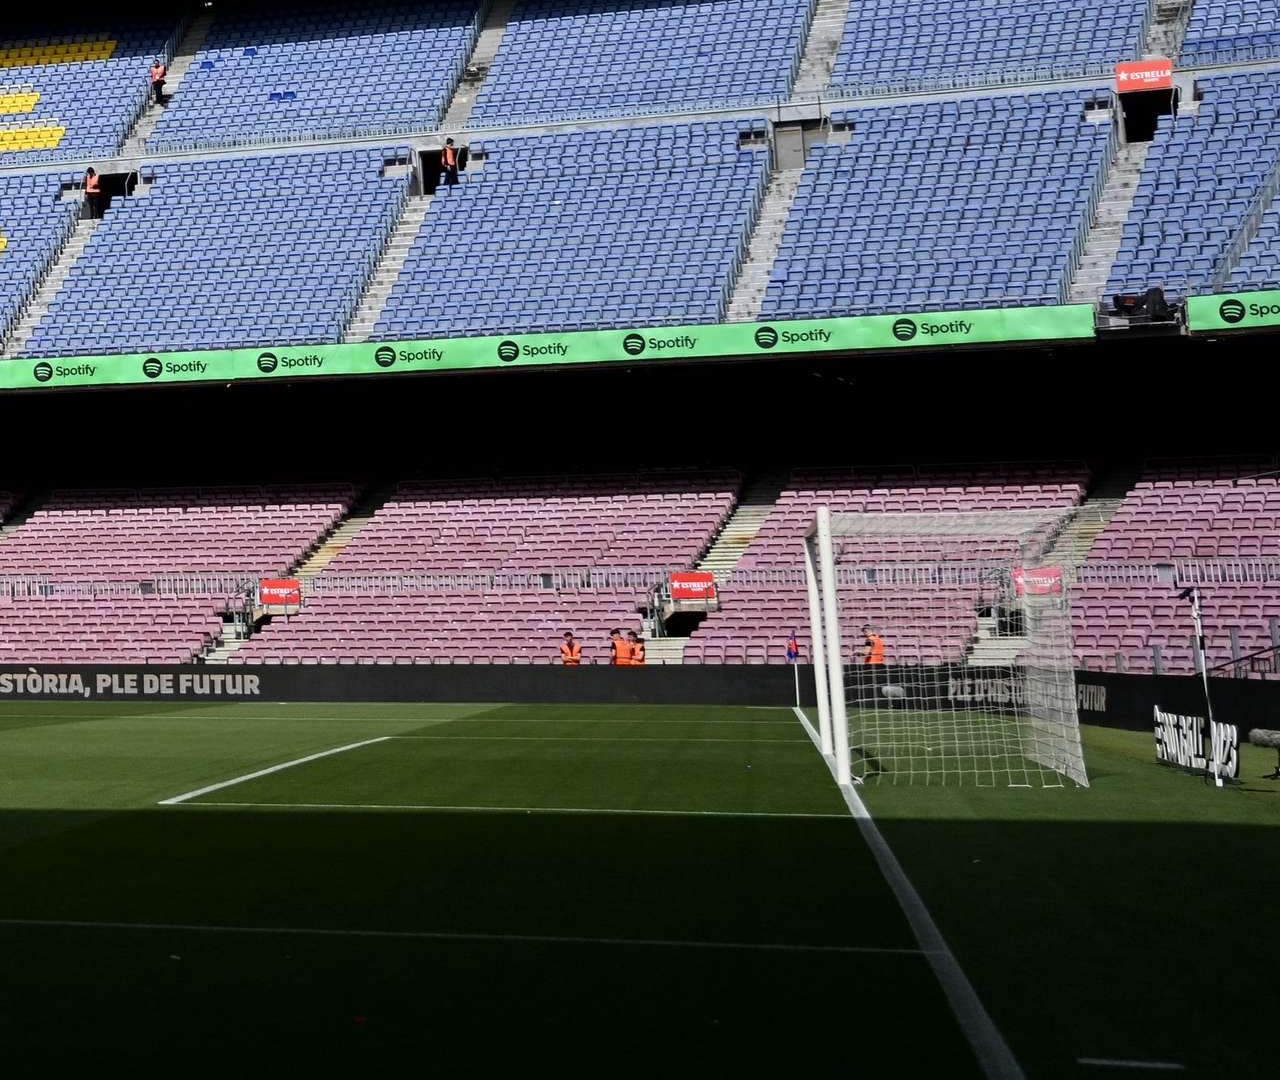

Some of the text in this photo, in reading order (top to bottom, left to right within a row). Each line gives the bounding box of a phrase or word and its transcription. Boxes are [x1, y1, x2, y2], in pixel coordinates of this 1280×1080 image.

[1130, 69, 1172, 81] ESTRELLA
[782, 328, 832, 345] Spotify
[921, 320, 973, 337] Spotify
[523, 342, 569, 358] Spotify
[649, 335, 697, 351] Spotify
[281, 354, 324, 369] Spotify
[400, 348, 444, 363] Spotify
[56, 364, 97, 378] Spotify
[166, 360, 208, 375] Spotify
[96, 673, 139, 695] PLE
[144, 674, 177, 695] DE
[180, 674, 260, 695] FUTUR
[1077, 684, 1106, 712] FUTUR
